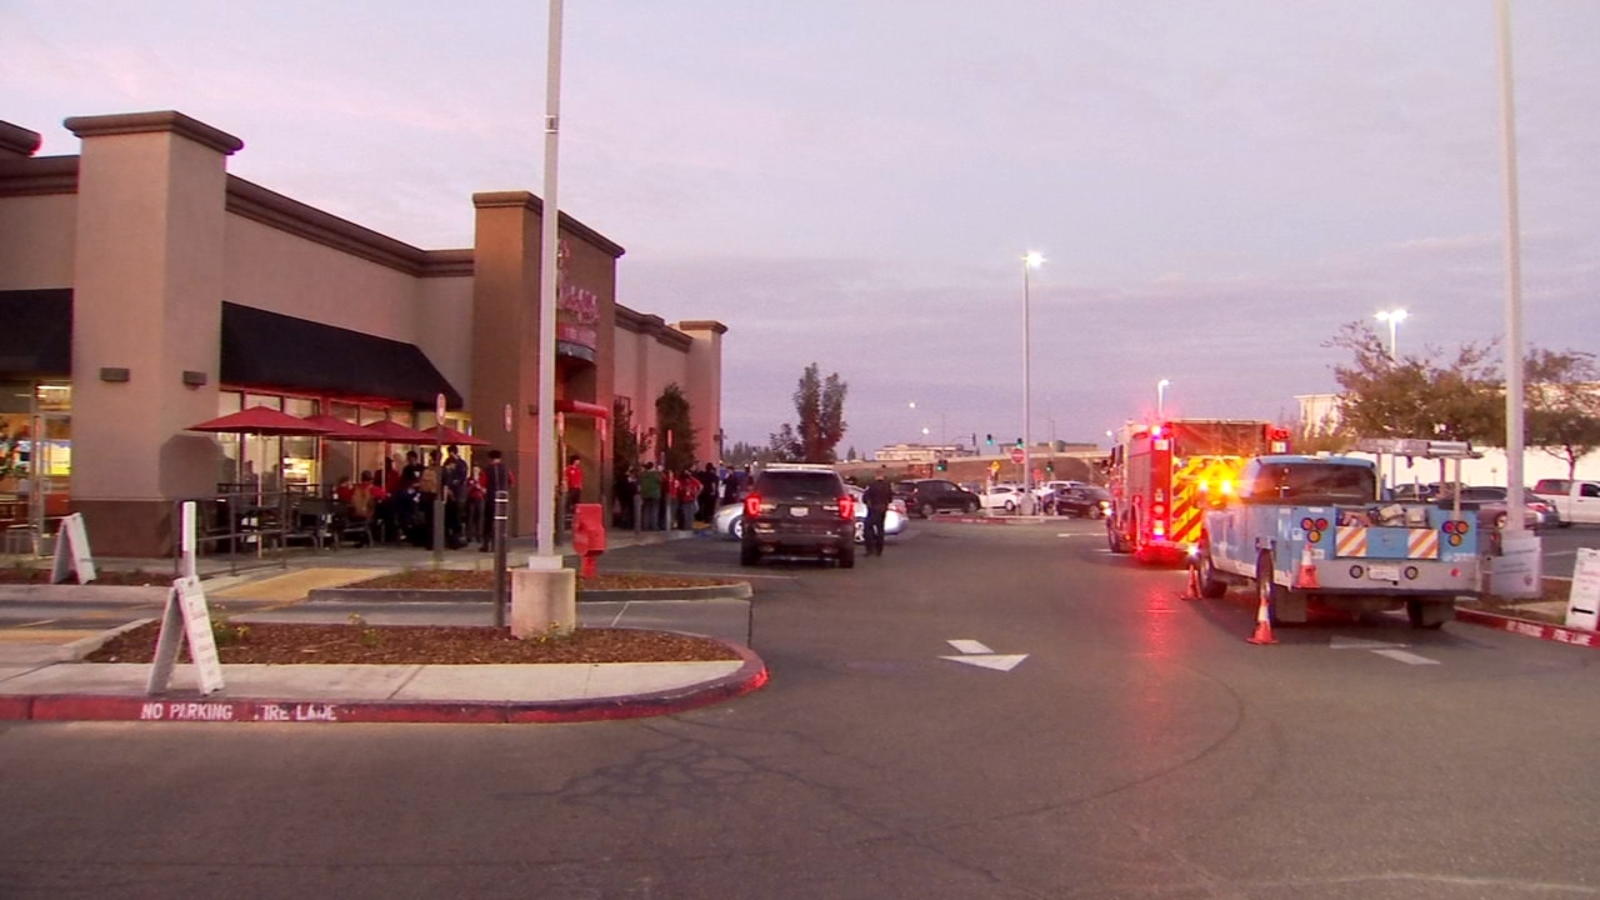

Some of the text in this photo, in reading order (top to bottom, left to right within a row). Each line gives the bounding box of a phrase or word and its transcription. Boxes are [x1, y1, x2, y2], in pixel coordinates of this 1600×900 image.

[140, 703, 164, 719] NO
[169, 704, 233, 719] PARKING
[253, 704, 290, 720] IRE
